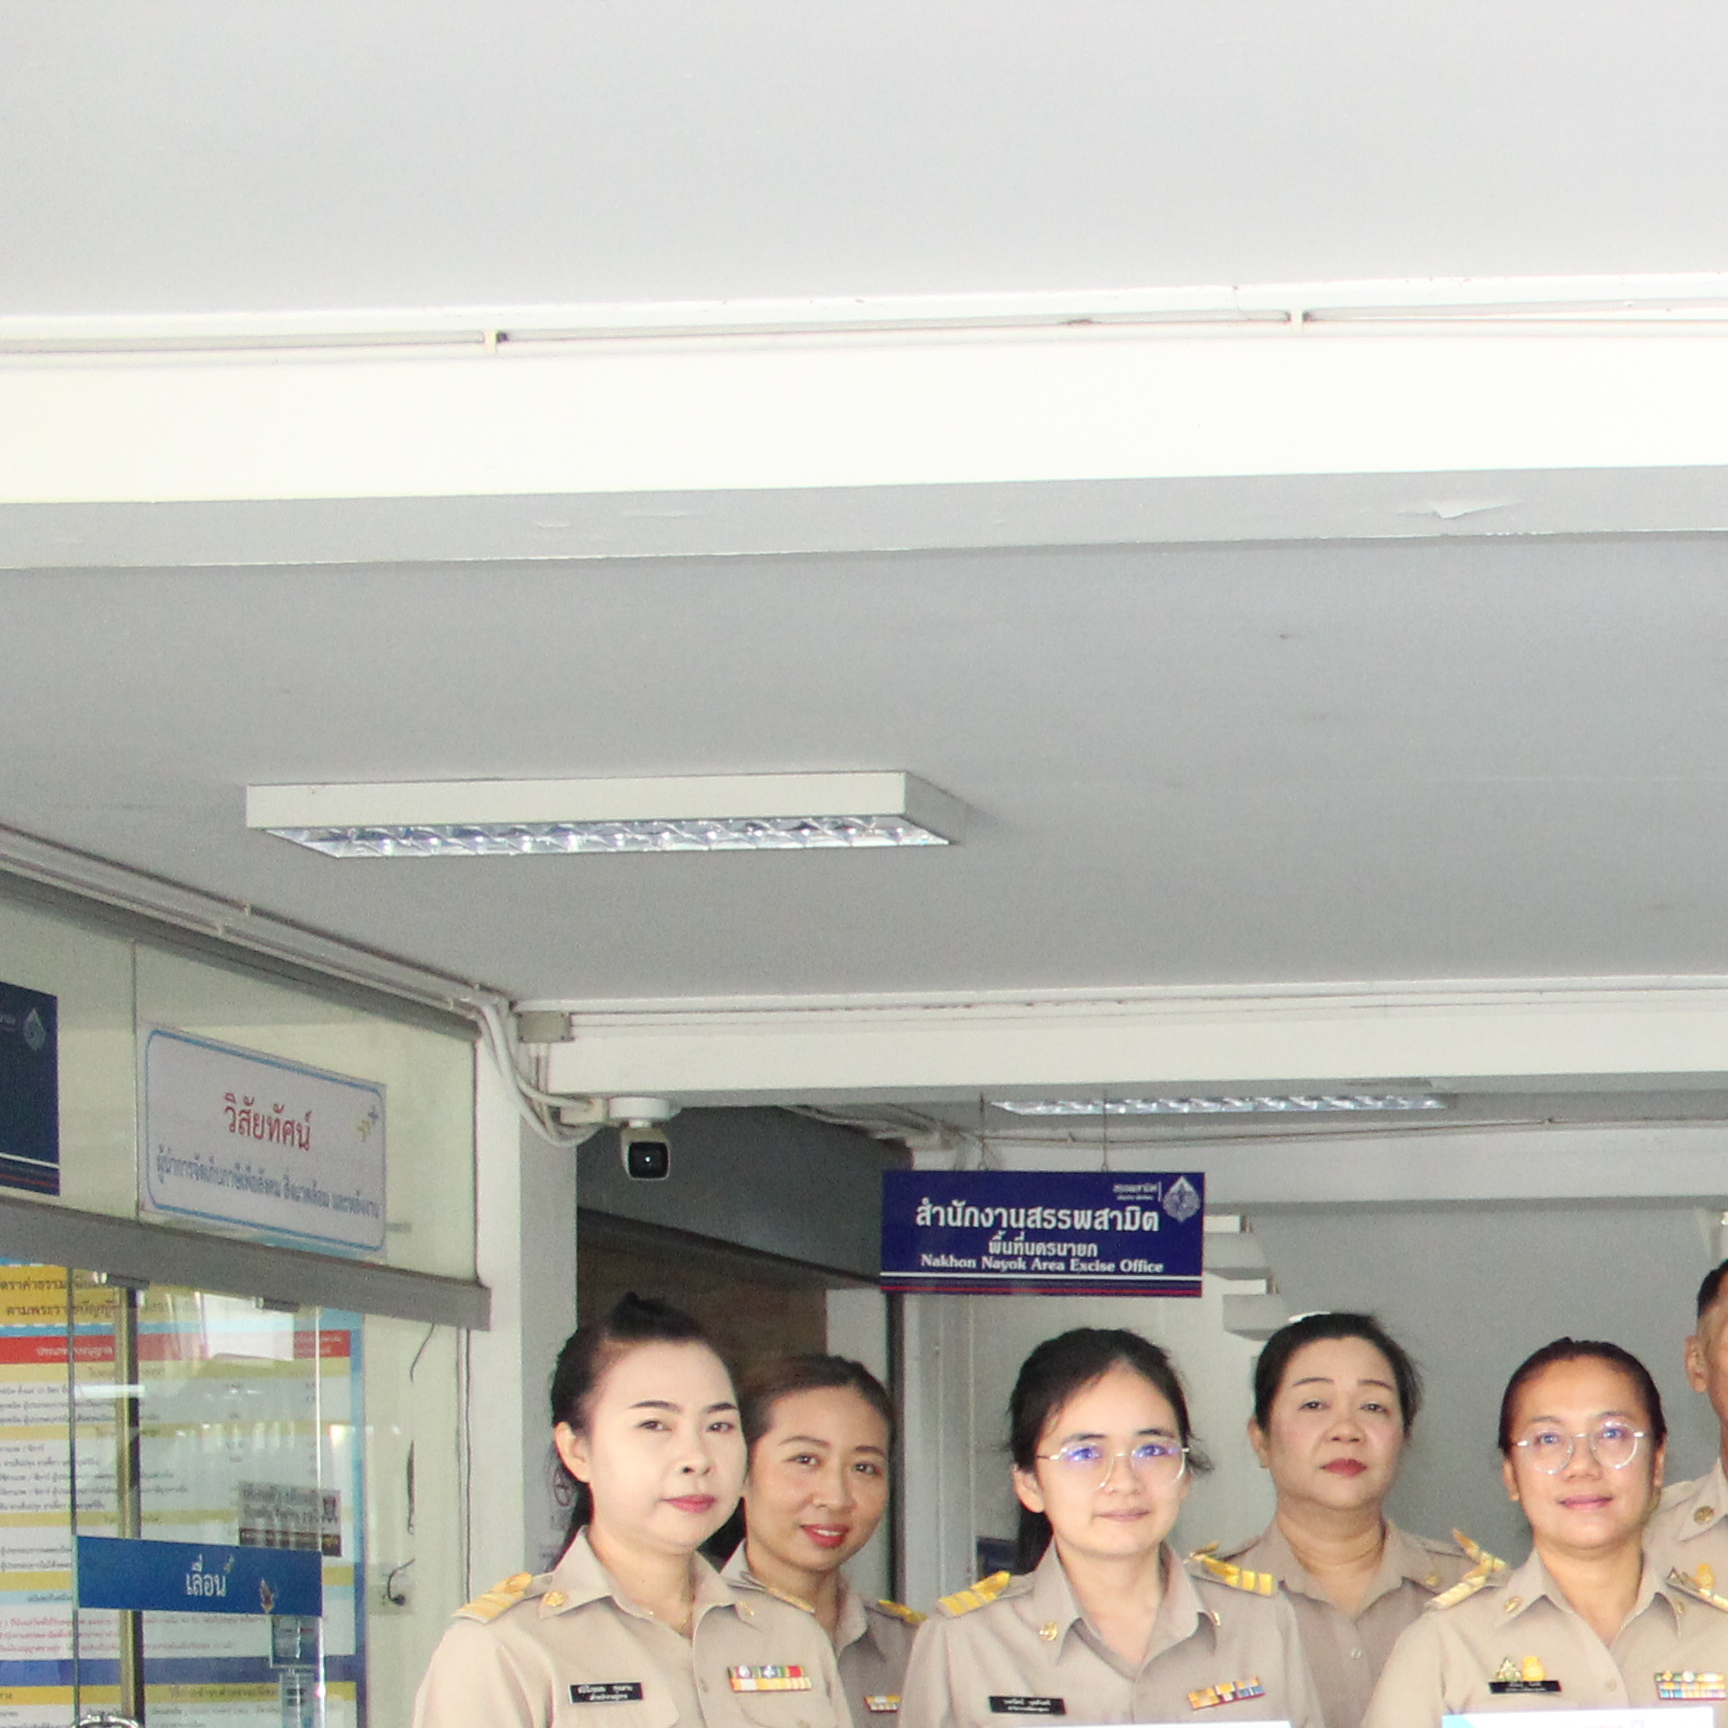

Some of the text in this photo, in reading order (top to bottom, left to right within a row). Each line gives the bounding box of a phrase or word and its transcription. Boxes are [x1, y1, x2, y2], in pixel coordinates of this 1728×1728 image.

[223, 1091, 313, 1152] วิสัยทัศน์
[915, 1197, 1160, 1233] สำนักงานสรรพสามิต
[988, 1230, 1099, 1258] พื้นที่นครนายก
[921, 1253, 1164, 1274] Nakhon Nayok Area Excise Office
[184, 1555, 228, 1598] เลื่อน
